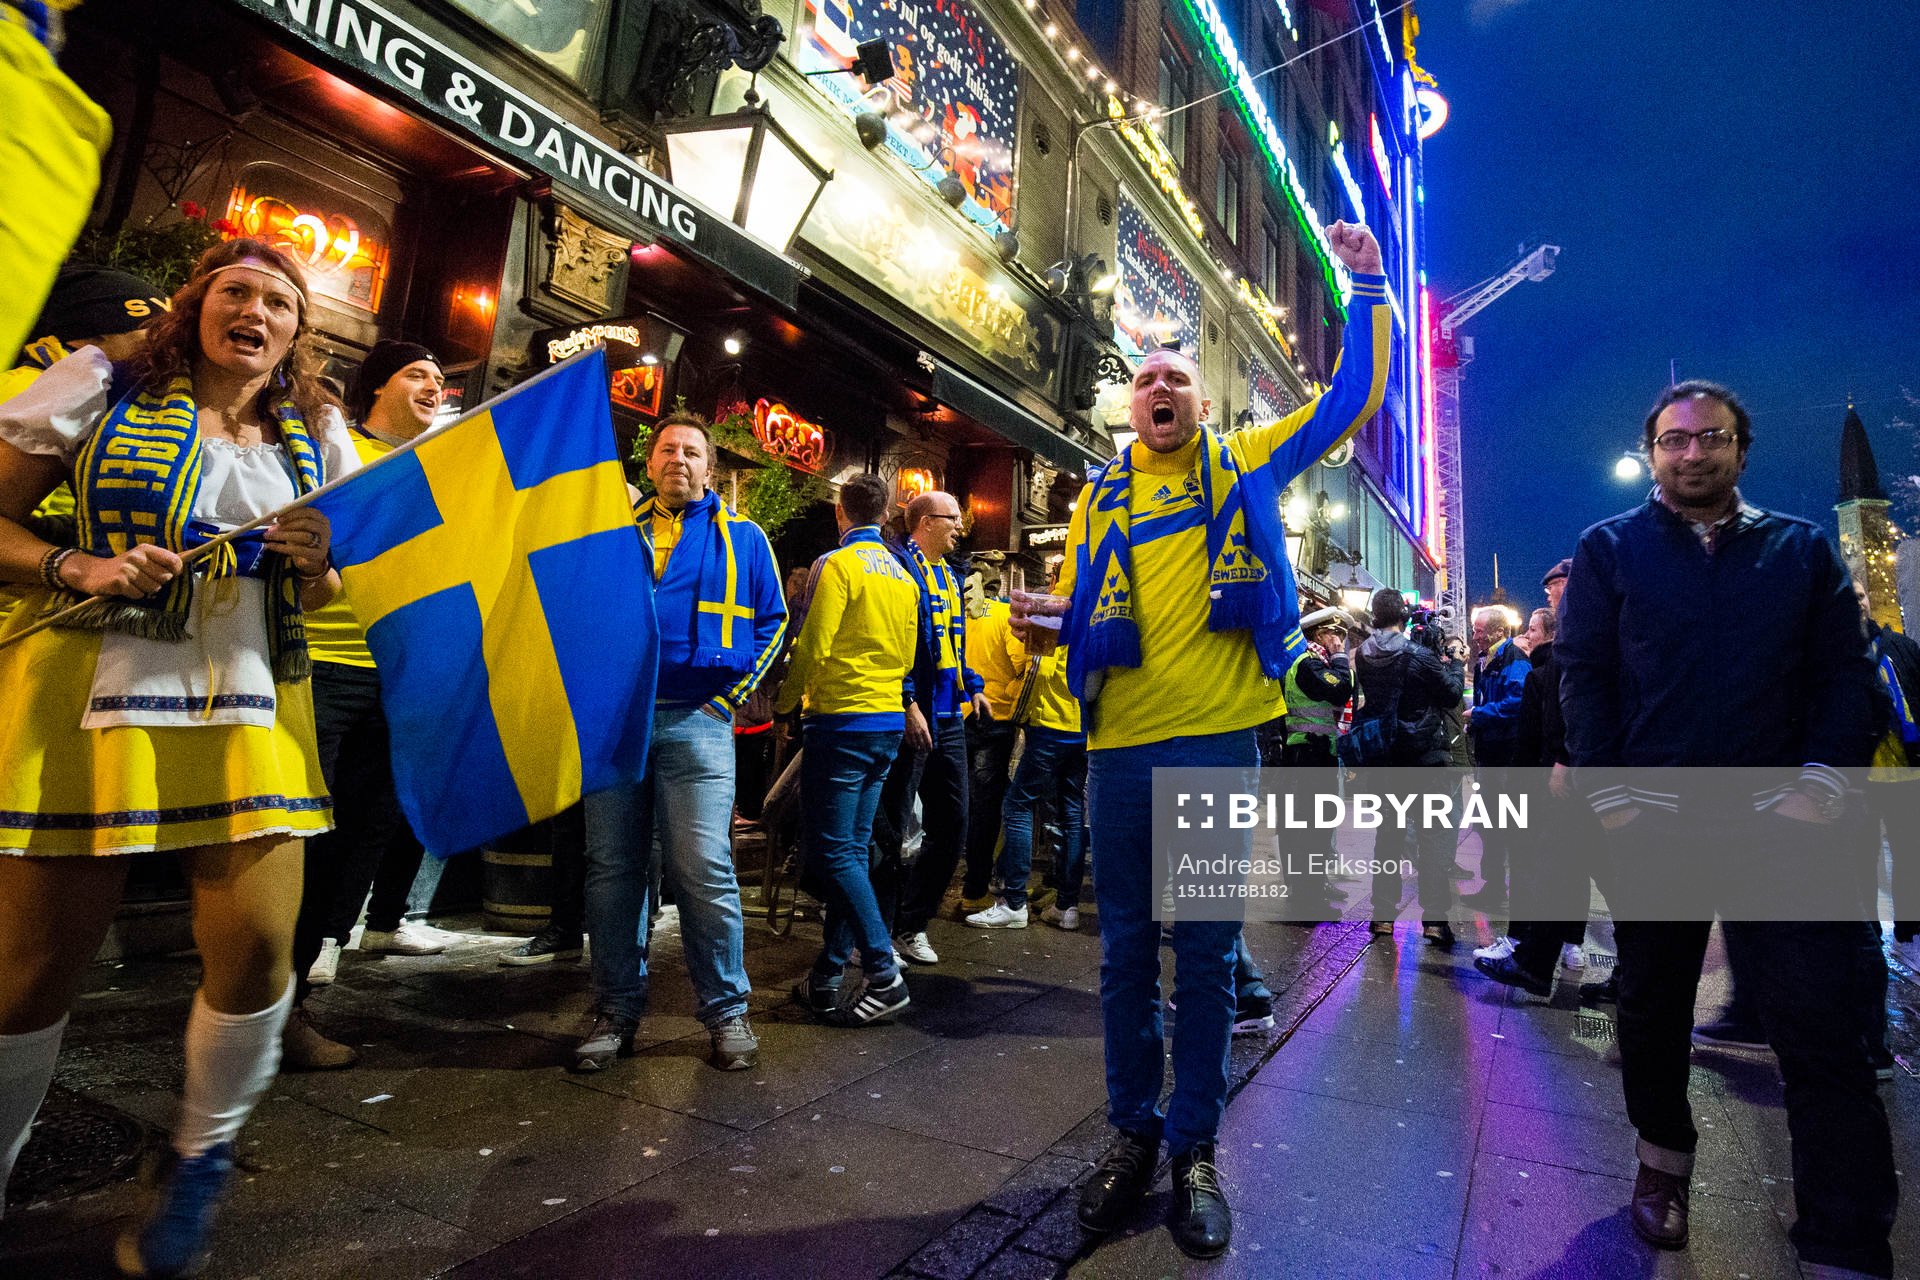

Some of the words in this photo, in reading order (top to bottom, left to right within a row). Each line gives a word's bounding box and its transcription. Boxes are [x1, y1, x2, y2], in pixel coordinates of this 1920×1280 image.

[920, 24, 936, 52] og
[936, 43, 962, 78] godt
[445, 71, 483, 125] &
[498, 100, 697, 241] DANCING
[1213, 566, 1265, 582] SWEDEN
